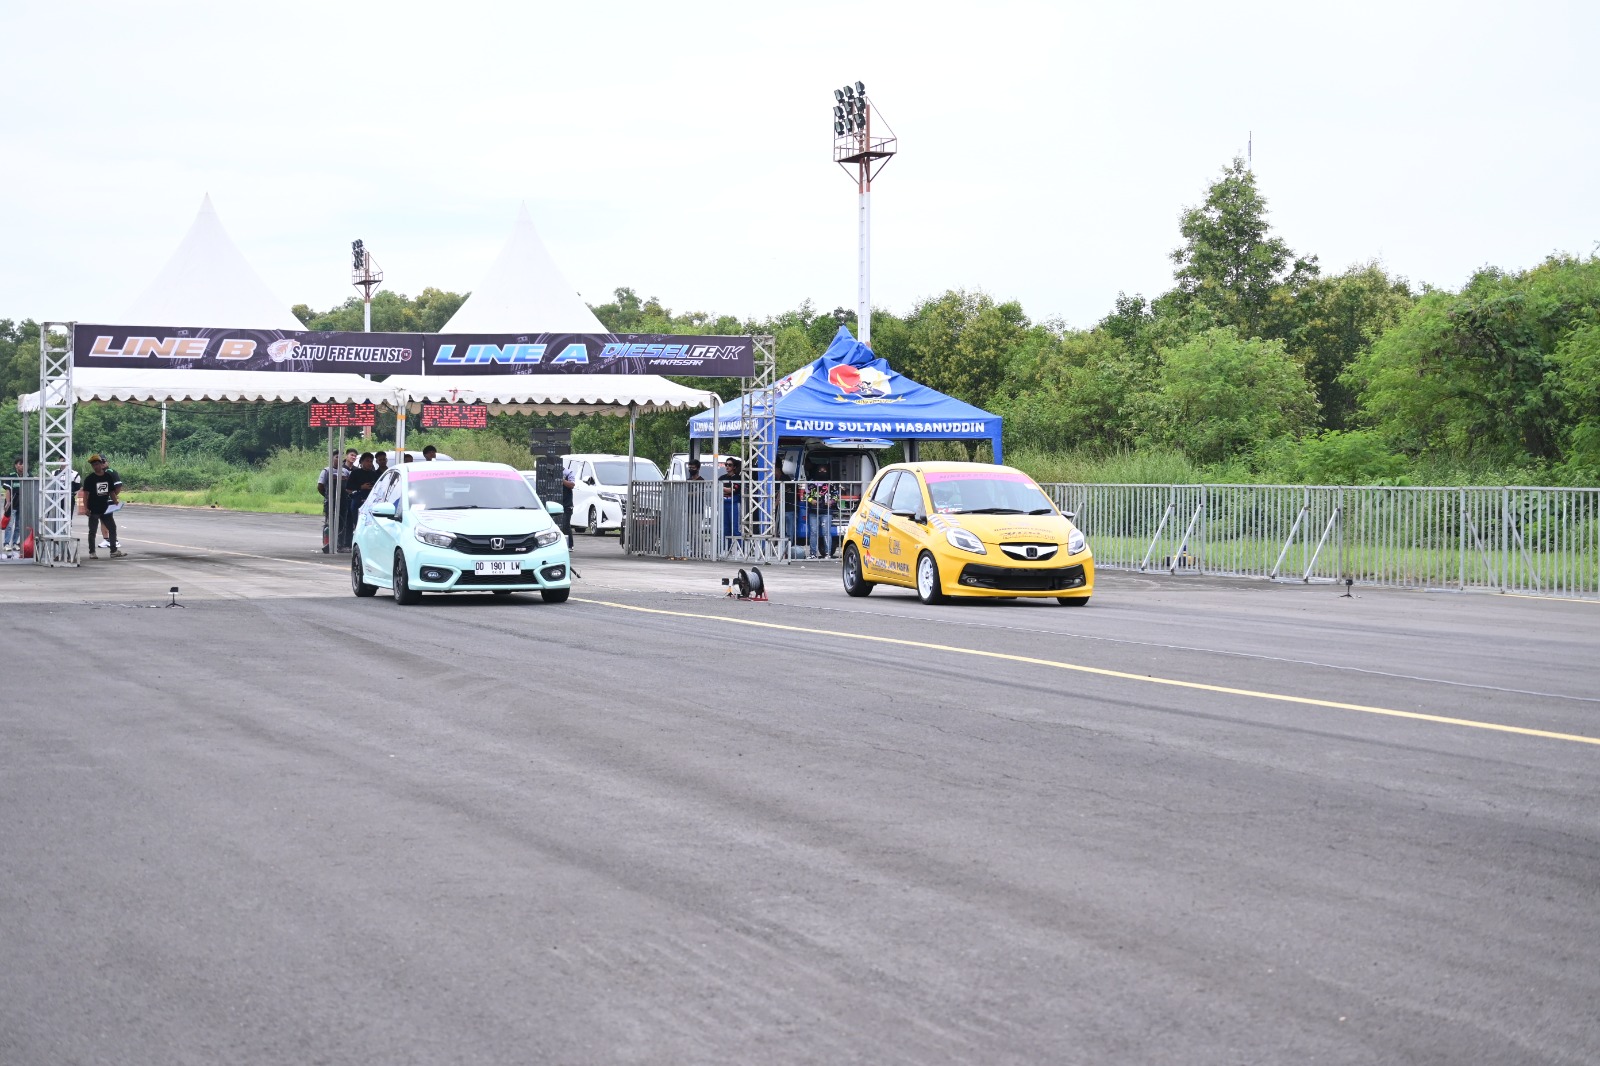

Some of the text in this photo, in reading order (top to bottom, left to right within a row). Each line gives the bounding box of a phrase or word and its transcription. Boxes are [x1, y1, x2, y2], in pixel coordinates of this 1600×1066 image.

[89, 336, 258, 360] LINE B
[291, 345, 326, 361] SATU
[328, 346, 402, 363] FREKUENSI
[433, 343, 547, 365] LINE
[551, 343, 589, 364] A
[785, 419, 985, 433] LANUD SULTAN HASANUDDIN
[475, 561, 520, 571] DD 1901 LW
